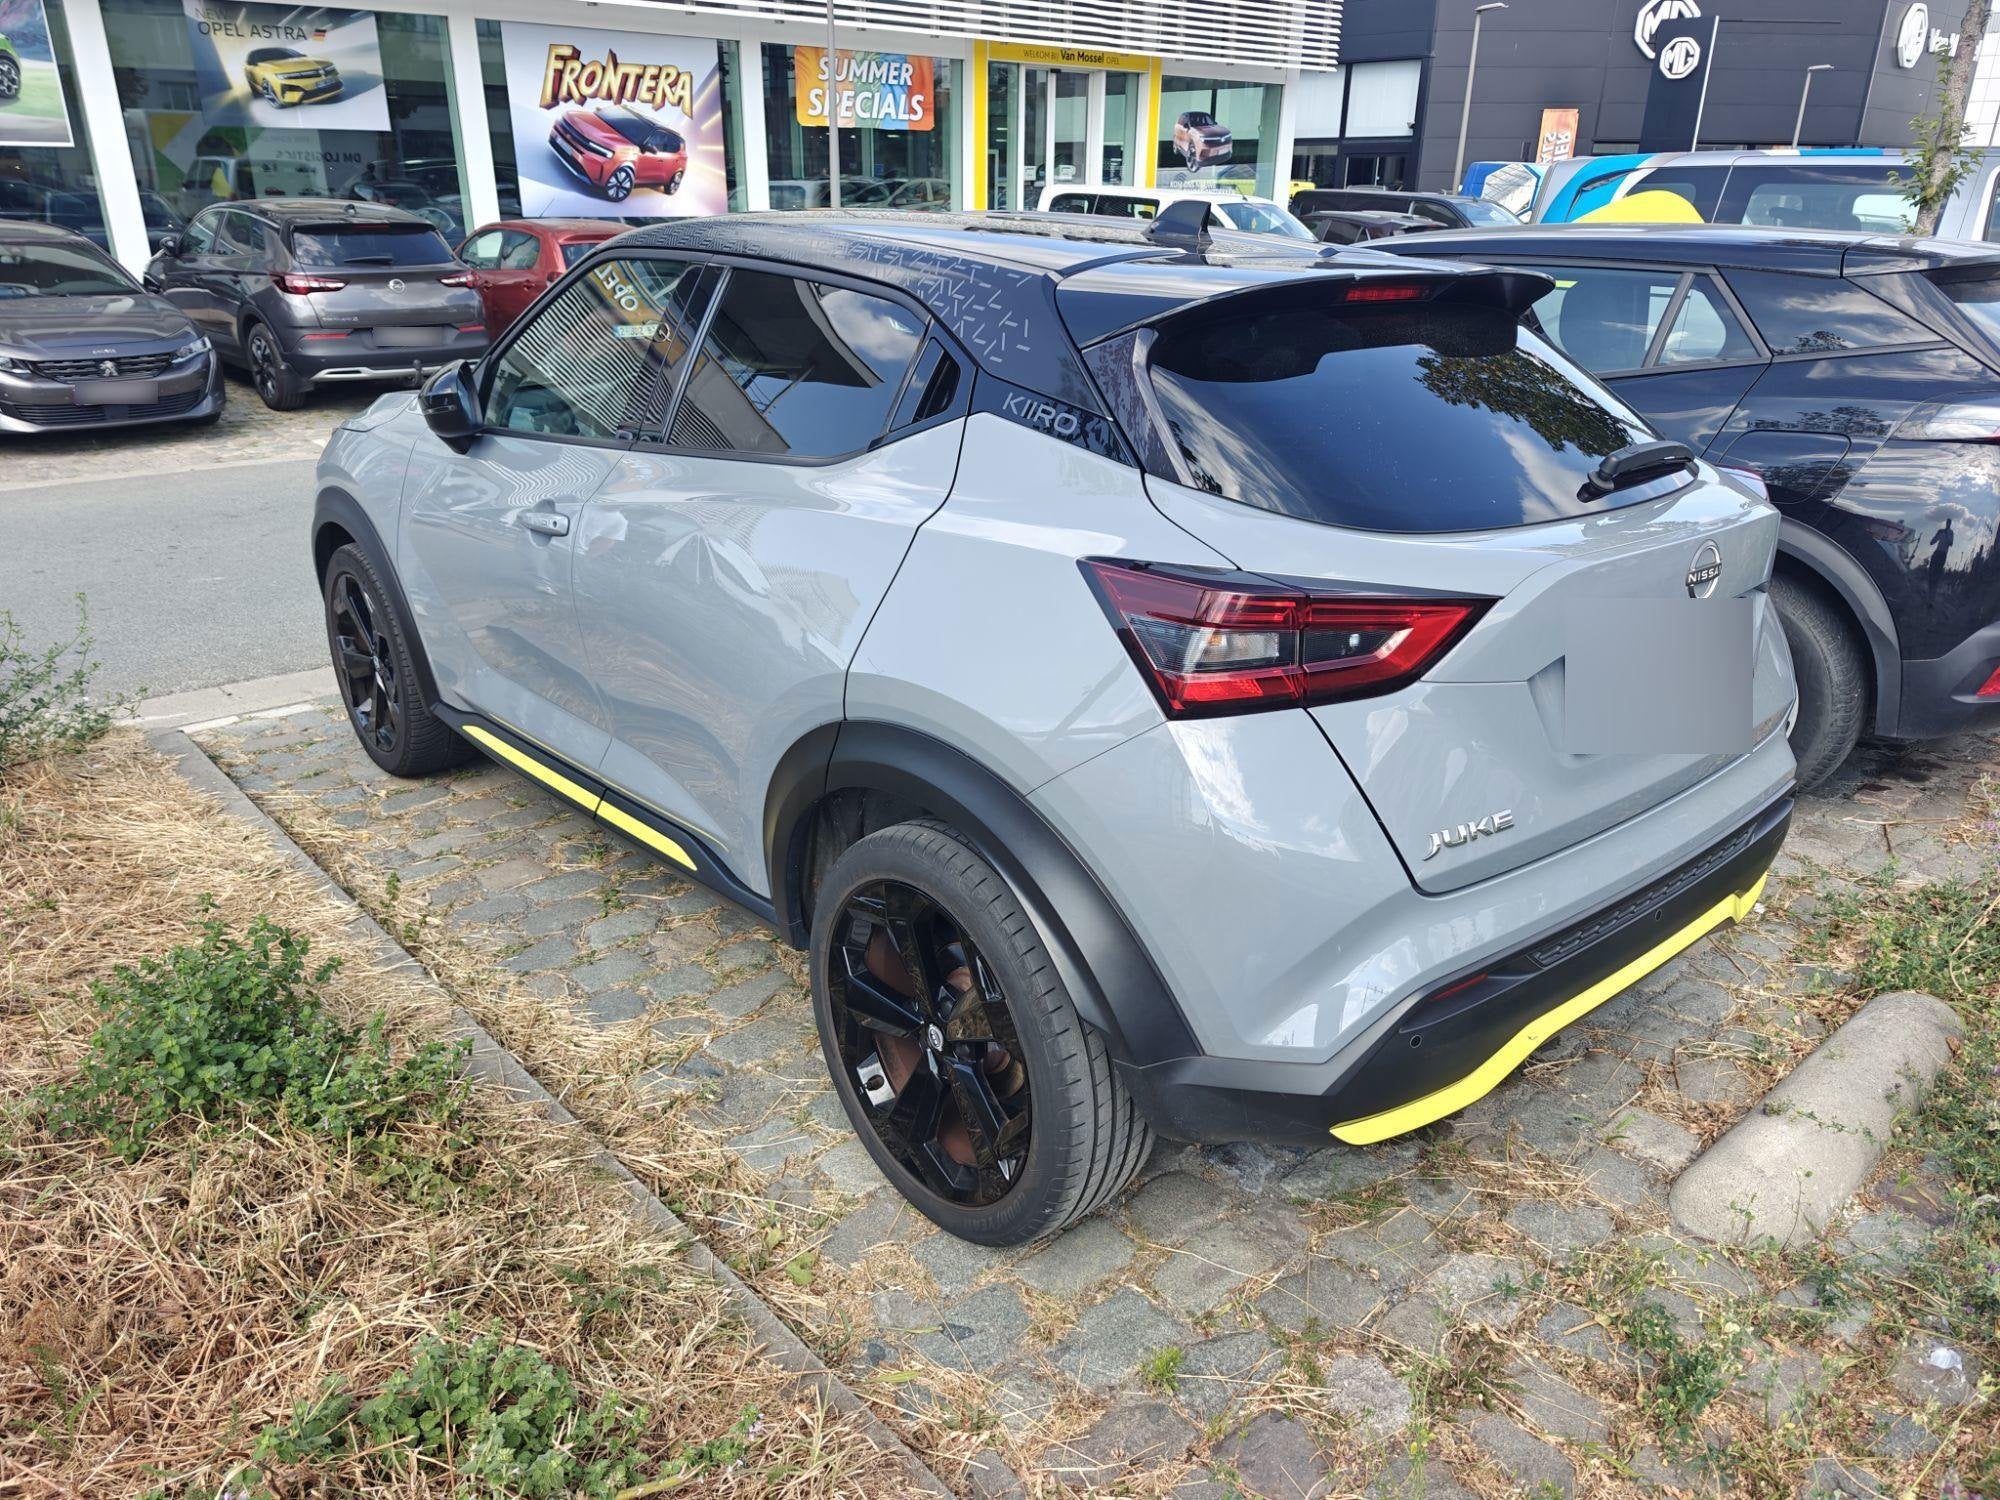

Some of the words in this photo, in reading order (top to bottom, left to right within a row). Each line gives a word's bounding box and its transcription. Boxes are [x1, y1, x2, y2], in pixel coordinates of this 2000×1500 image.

[197, 21, 245, 38] OPEL
[250, 24, 308, 41] ASTRA
[818, 56, 914, 86] SUMMER
[1060, 49, 1075, 61] Van
[1077, 50, 1105, 64] Mossel
[1663, 40, 1696, 75] MG
[1002, 392, 1078, 435] KIIRO
[1421, 808, 1515, 862] JUKE
